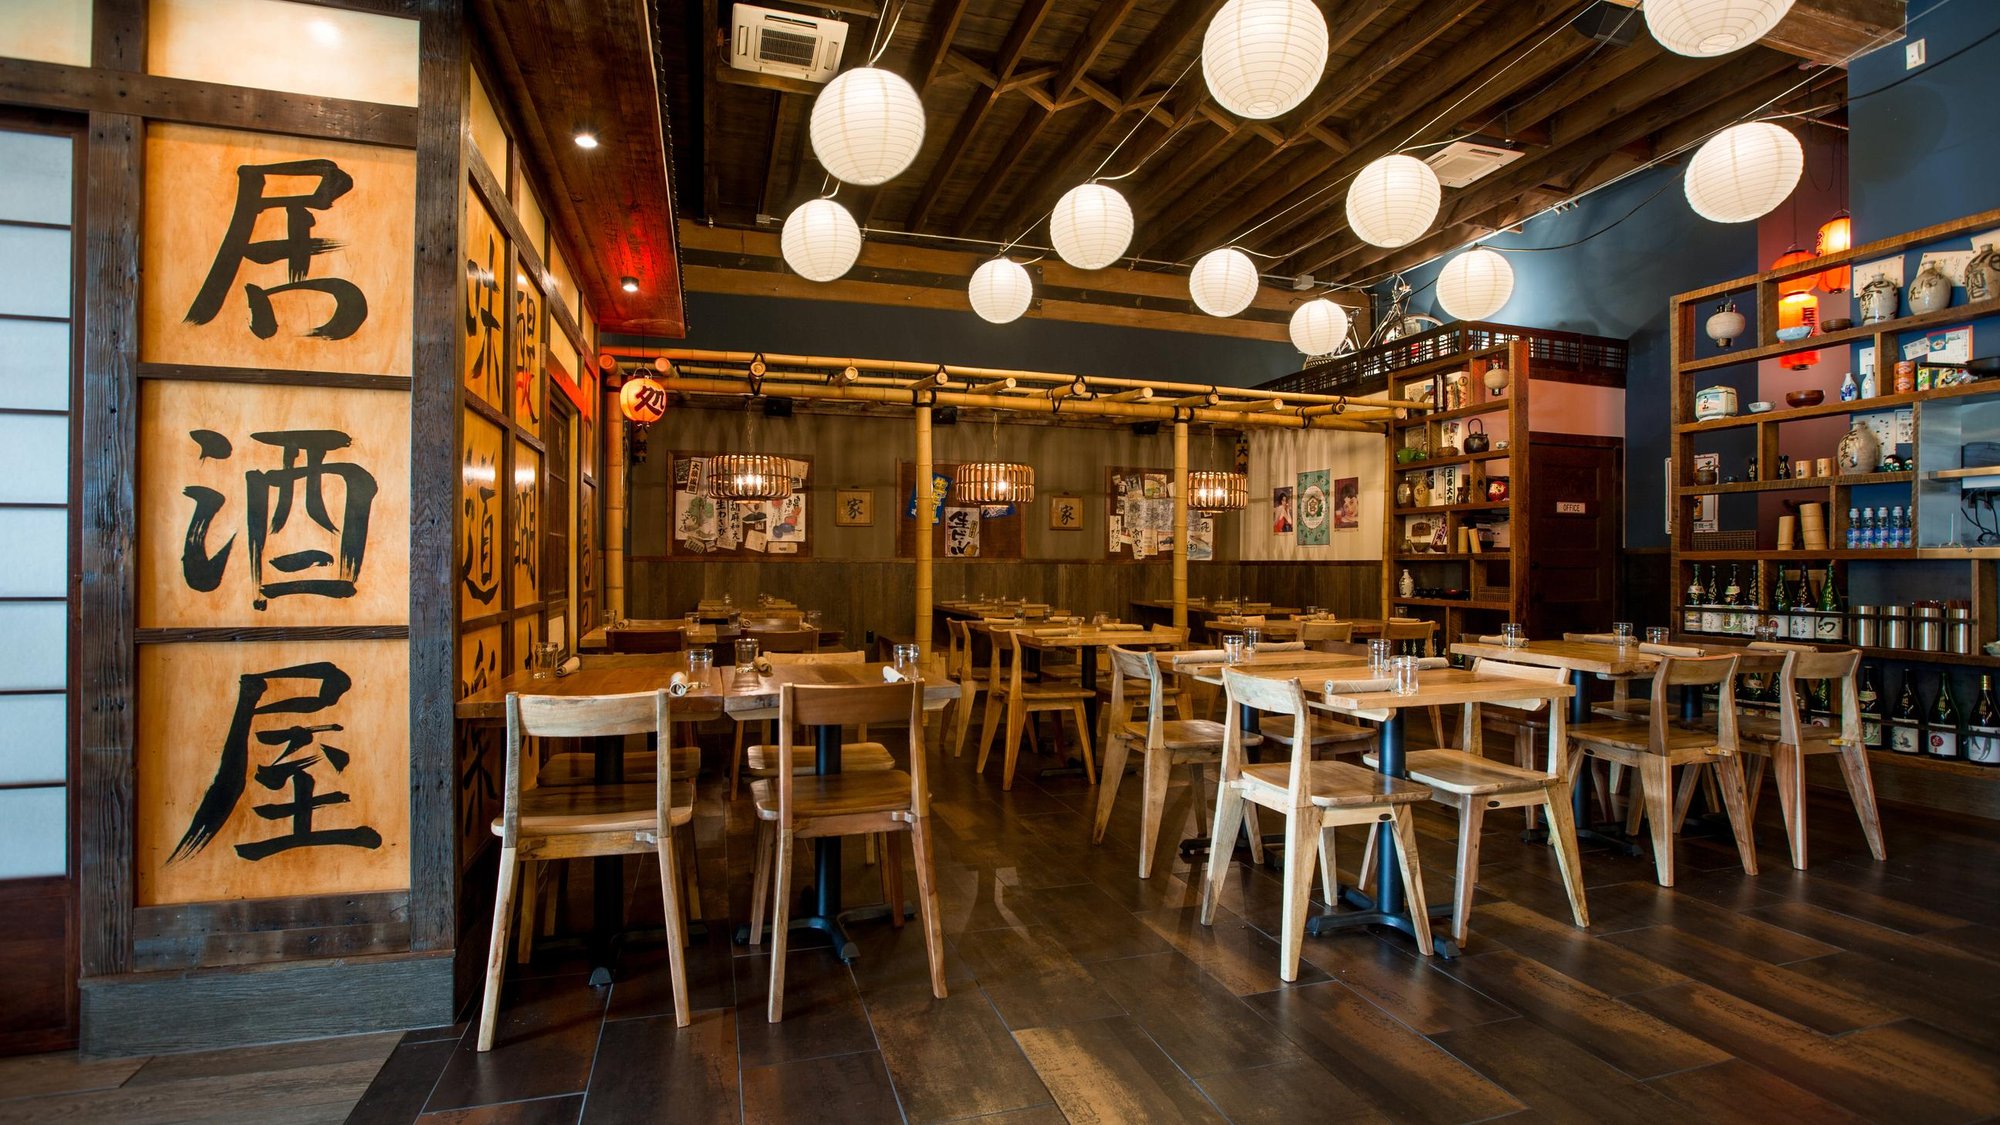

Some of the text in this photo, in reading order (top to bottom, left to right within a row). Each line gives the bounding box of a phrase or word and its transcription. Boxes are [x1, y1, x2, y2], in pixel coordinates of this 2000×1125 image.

[634, 385, 665, 416] 処
[166, 159, 382, 867] 居酒屋
[847, 498, 864, 520] 家
[1060, 504, 1075, 525] 家
[1562, 503, 1581, 512] OFFICE
[948, 510, 971, 555] 生ビール
